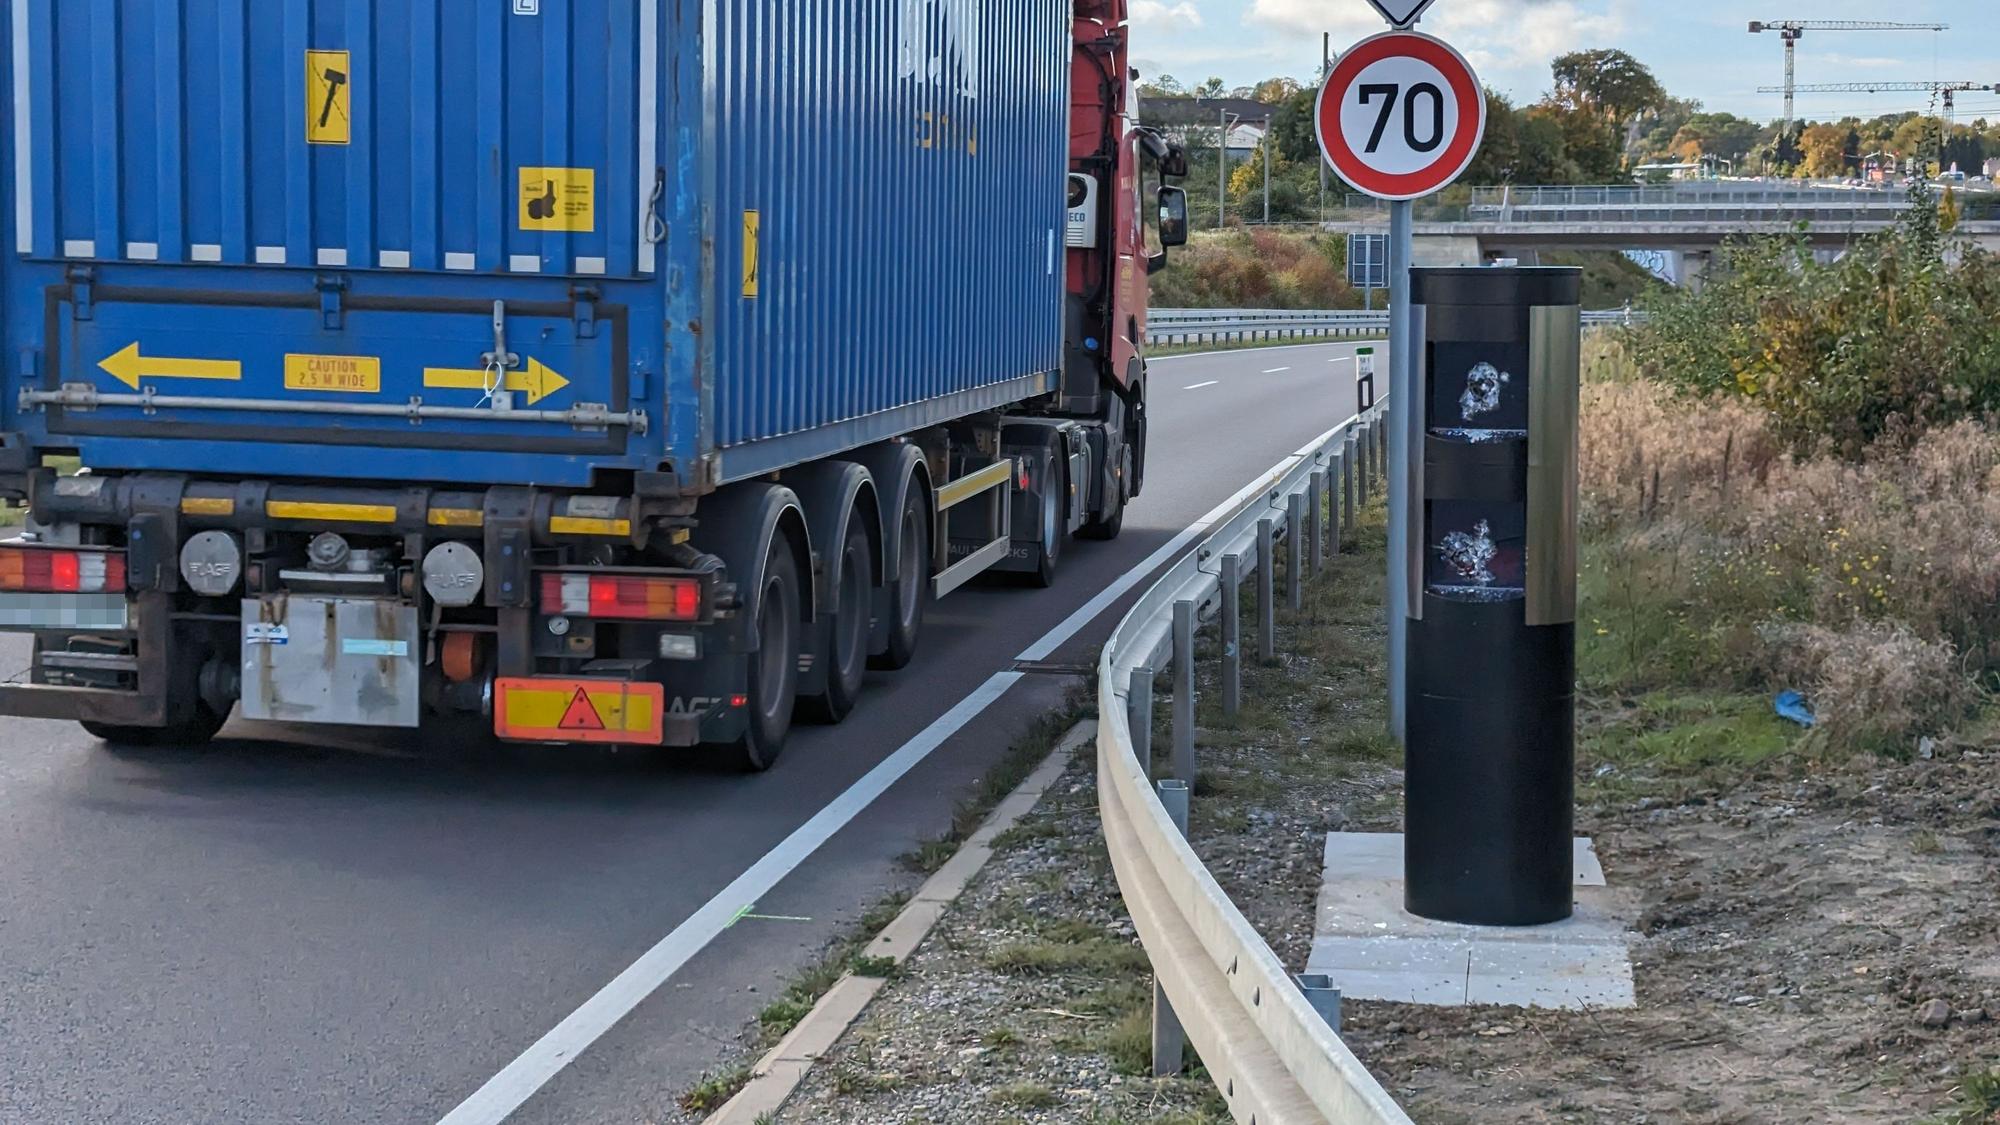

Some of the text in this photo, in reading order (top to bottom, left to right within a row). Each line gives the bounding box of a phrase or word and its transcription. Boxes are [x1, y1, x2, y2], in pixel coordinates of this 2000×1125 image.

[1358, 82, 1444, 153] 70
[1068, 212, 1086, 222] ECO
[307, 360, 357, 373] CAUTION
[299, 372, 366, 387] 2.5 M WIDE
